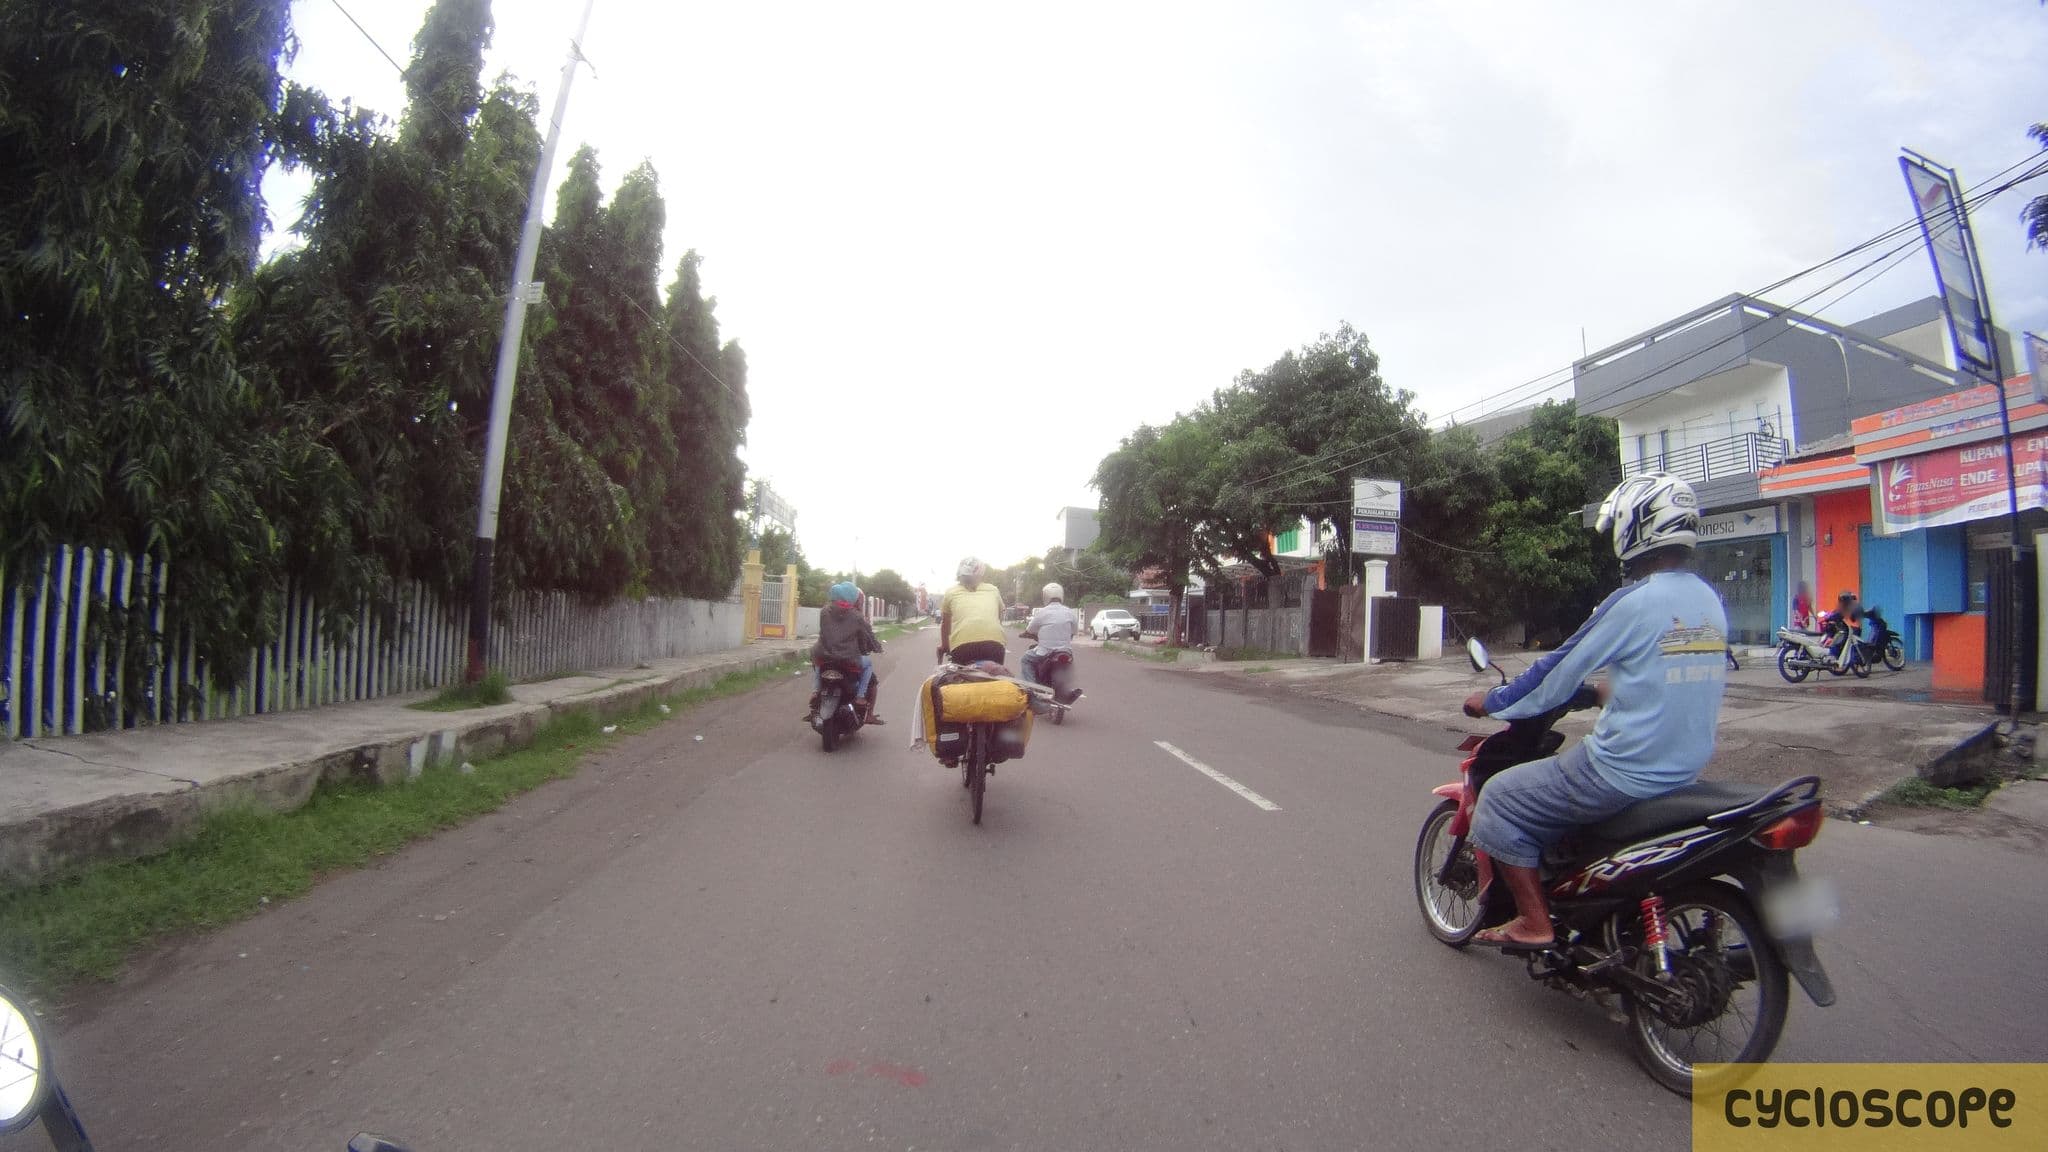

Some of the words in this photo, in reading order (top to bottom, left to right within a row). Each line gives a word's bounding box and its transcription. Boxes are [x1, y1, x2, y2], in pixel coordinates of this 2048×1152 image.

[1960, 443, 2006, 464] KUPAN
[1960, 468, 1998, 487] ENDE
[1698, 520, 1735, 536] onesia
